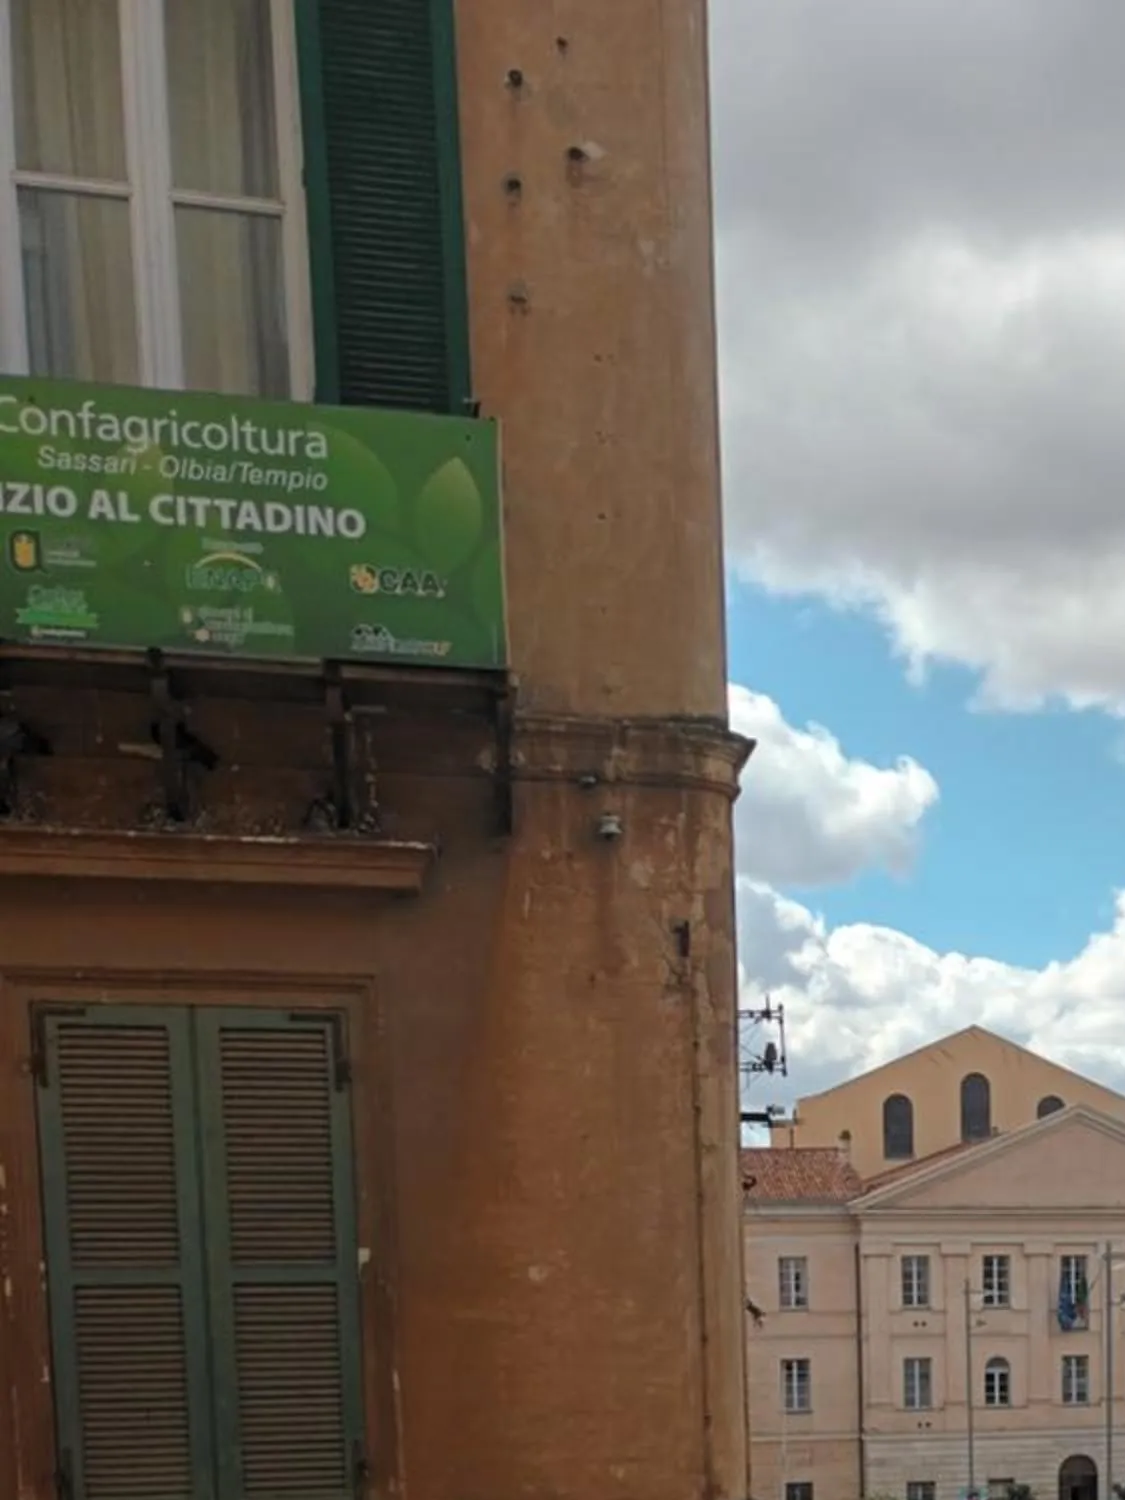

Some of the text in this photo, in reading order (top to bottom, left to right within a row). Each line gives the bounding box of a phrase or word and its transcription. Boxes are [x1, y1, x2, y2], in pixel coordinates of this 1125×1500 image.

[38, 444, 136, 475] Sassari
[158, 454, 328, 493] Olbia/Tempio
[87, 489, 141, 522] AL
[148, 494, 366, 539] CITTADINO
